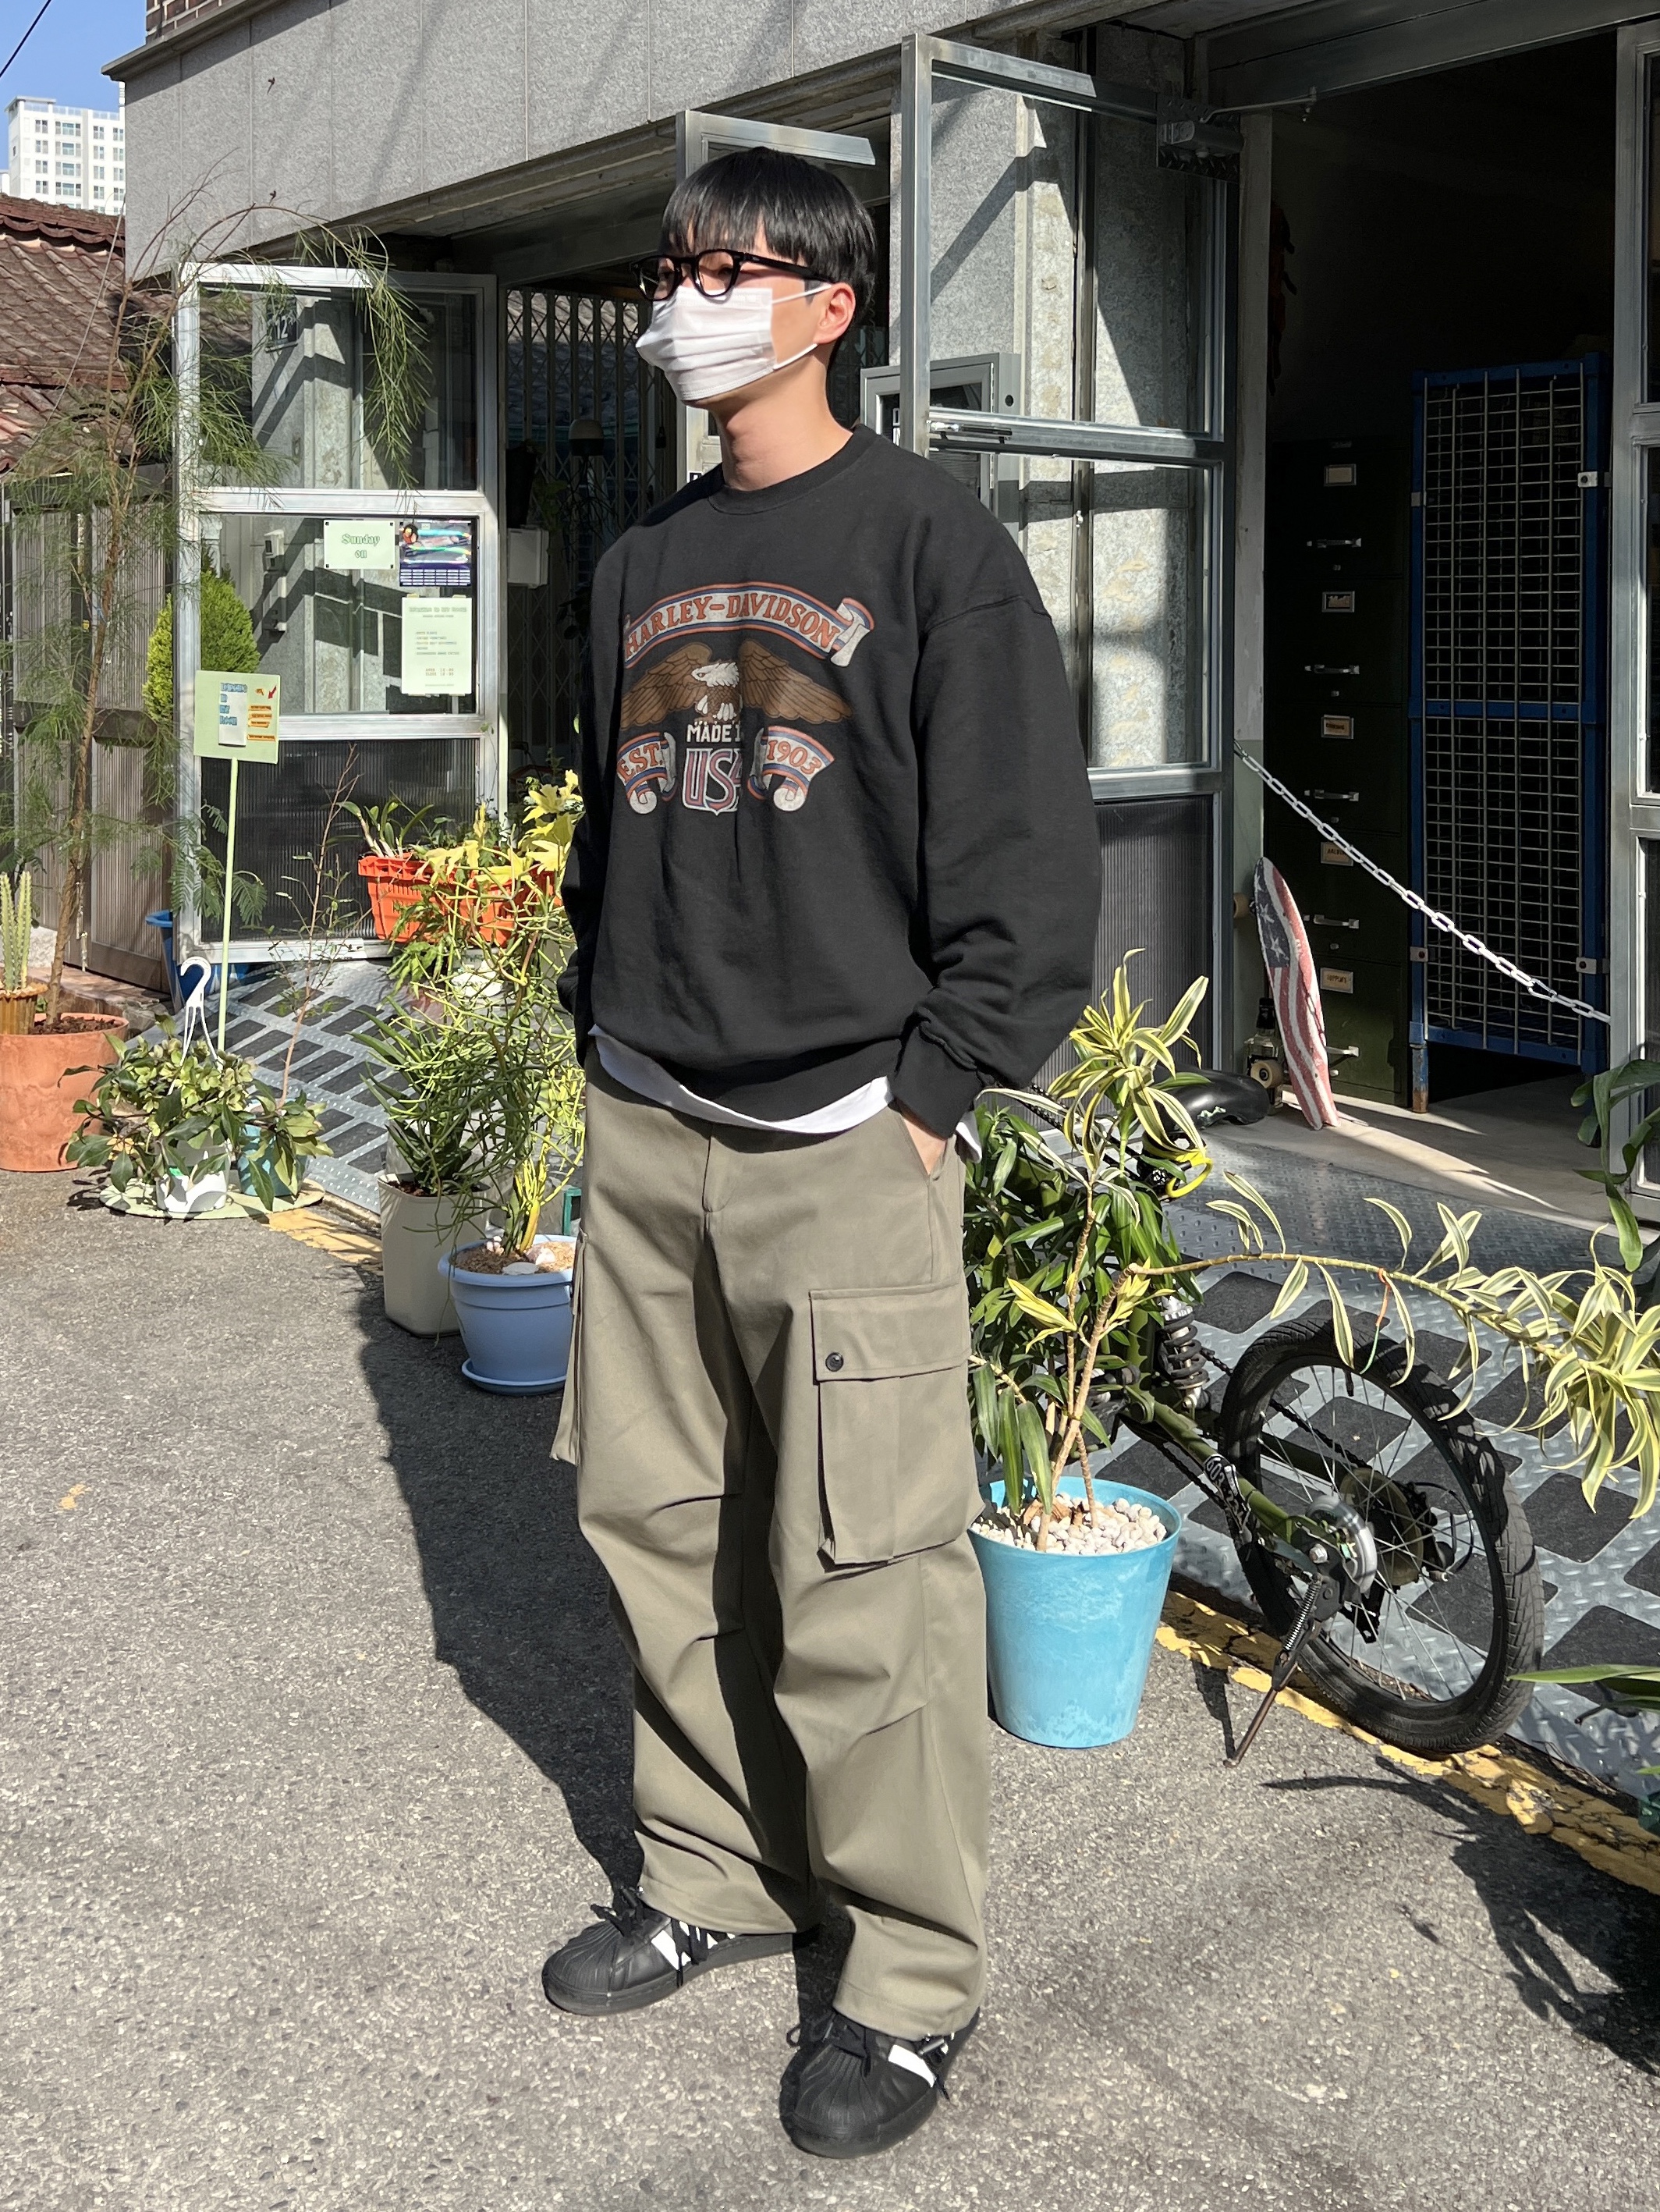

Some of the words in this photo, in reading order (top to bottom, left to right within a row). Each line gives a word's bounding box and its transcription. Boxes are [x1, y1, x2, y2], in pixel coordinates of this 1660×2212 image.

[341, 534, 380, 547] Sunday
[686, 723, 732, 742] MADE
[767, 740, 821, 775] 1903
